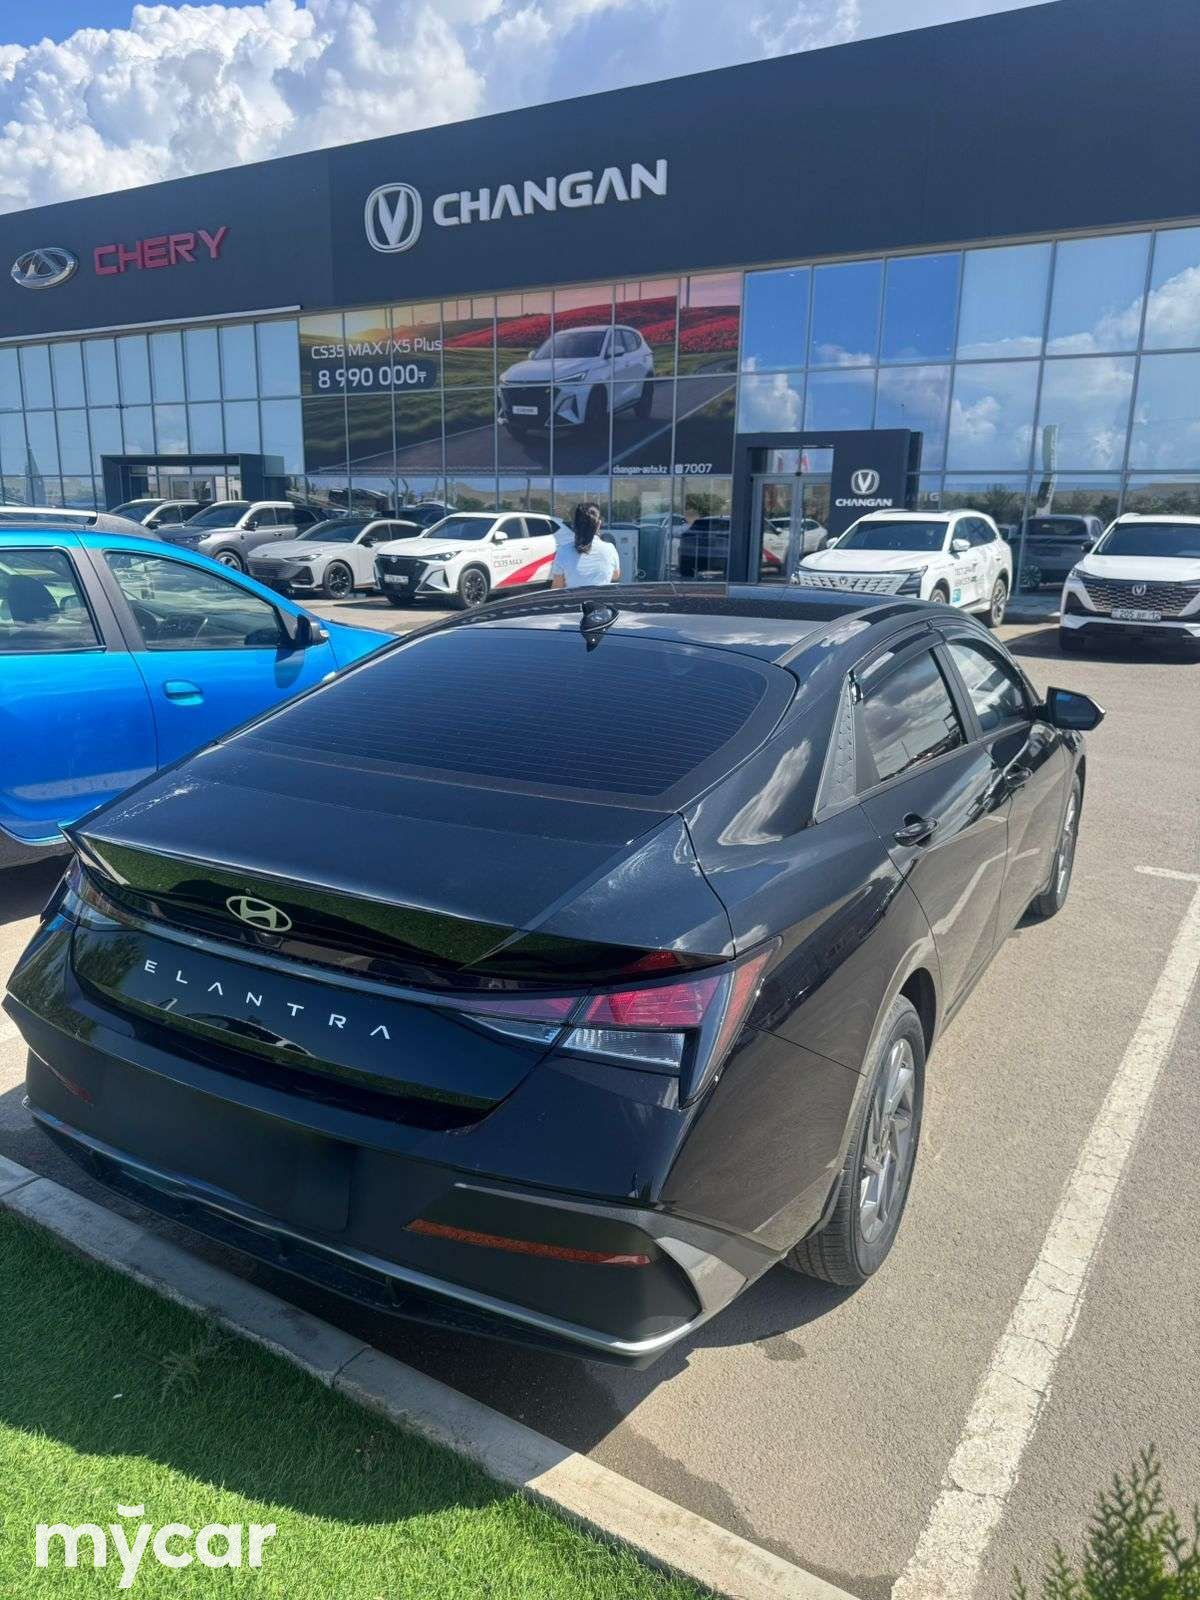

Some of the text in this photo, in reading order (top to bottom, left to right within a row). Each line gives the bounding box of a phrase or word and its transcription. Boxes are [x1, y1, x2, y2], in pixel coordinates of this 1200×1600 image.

[433, 159, 668, 227] CHANGAN
[93, 225, 227, 276] CHERY
[311, 344, 345, 359] CS35
[348, 341, 383, 356] MAX
[414, 336, 443, 351] Plus
[684, 463, 713, 474] 7007
[835, 498, 893, 507] CHANGAN
[144, 959, 391, 1040] ELANTRA
